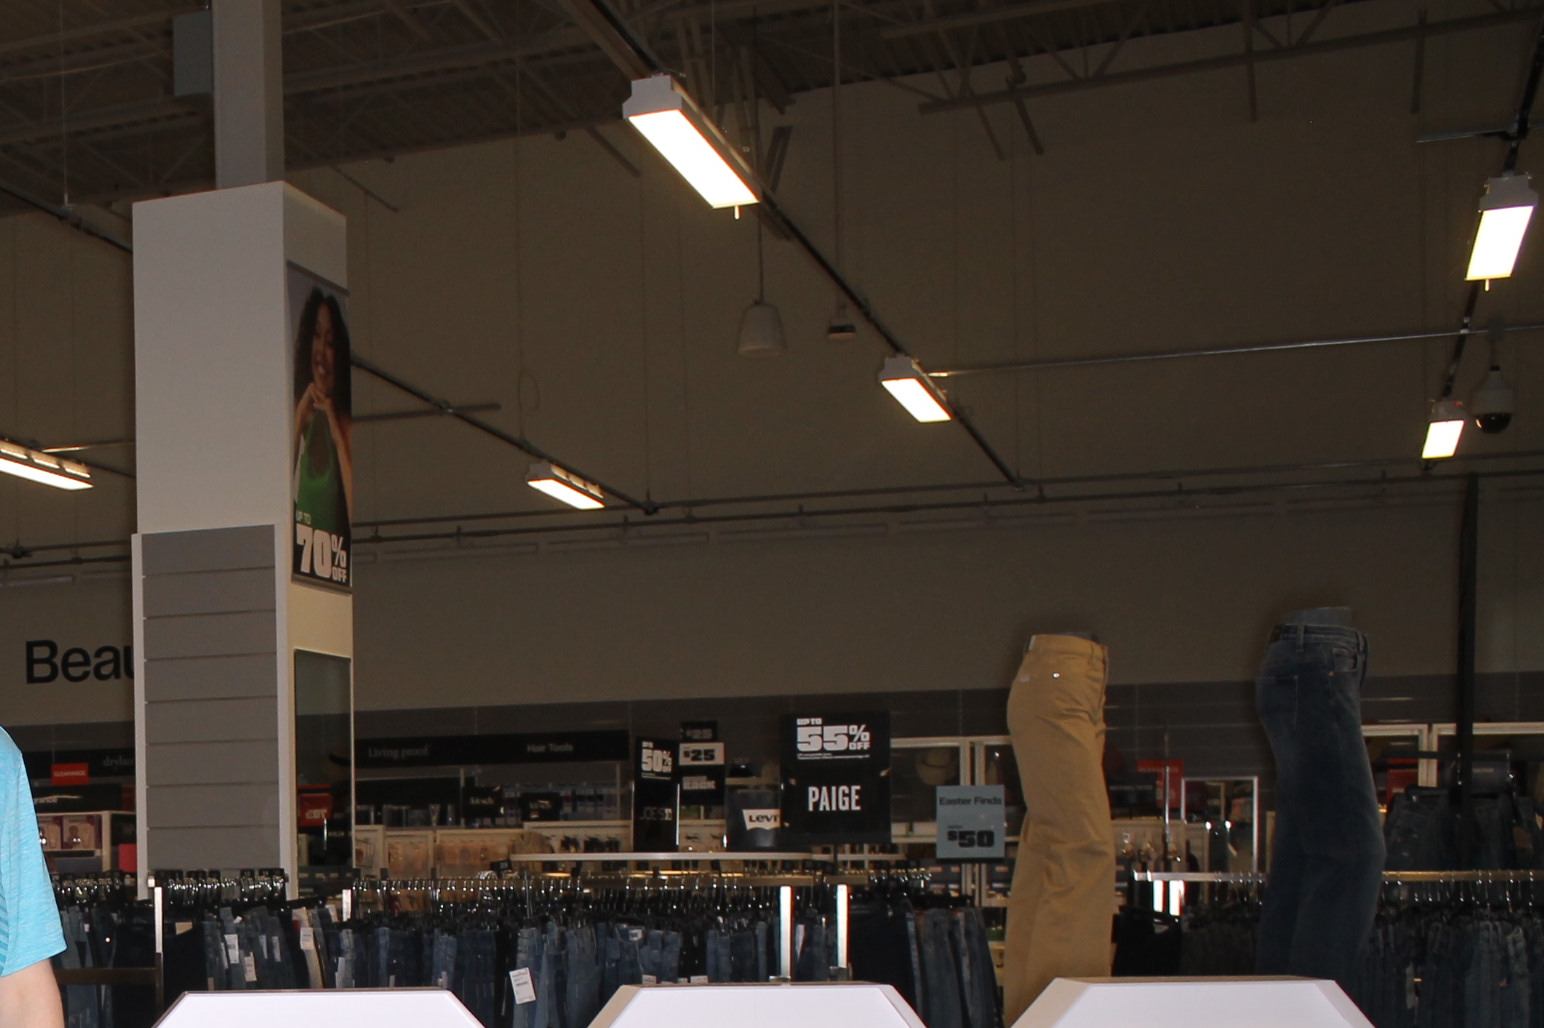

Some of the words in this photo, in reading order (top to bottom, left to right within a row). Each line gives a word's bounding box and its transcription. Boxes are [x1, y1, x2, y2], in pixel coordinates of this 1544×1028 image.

[296, 522, 347, 578] 70%
[797, 724, 870, 752] 55%
[682, 748, 715, 761] $25
[807, 785, 861, 812] PAIGE
[939, 796, 972, 806] Easter
[974, 796, 1003, 806] Finds
[947, 829, 995, 848] $50
